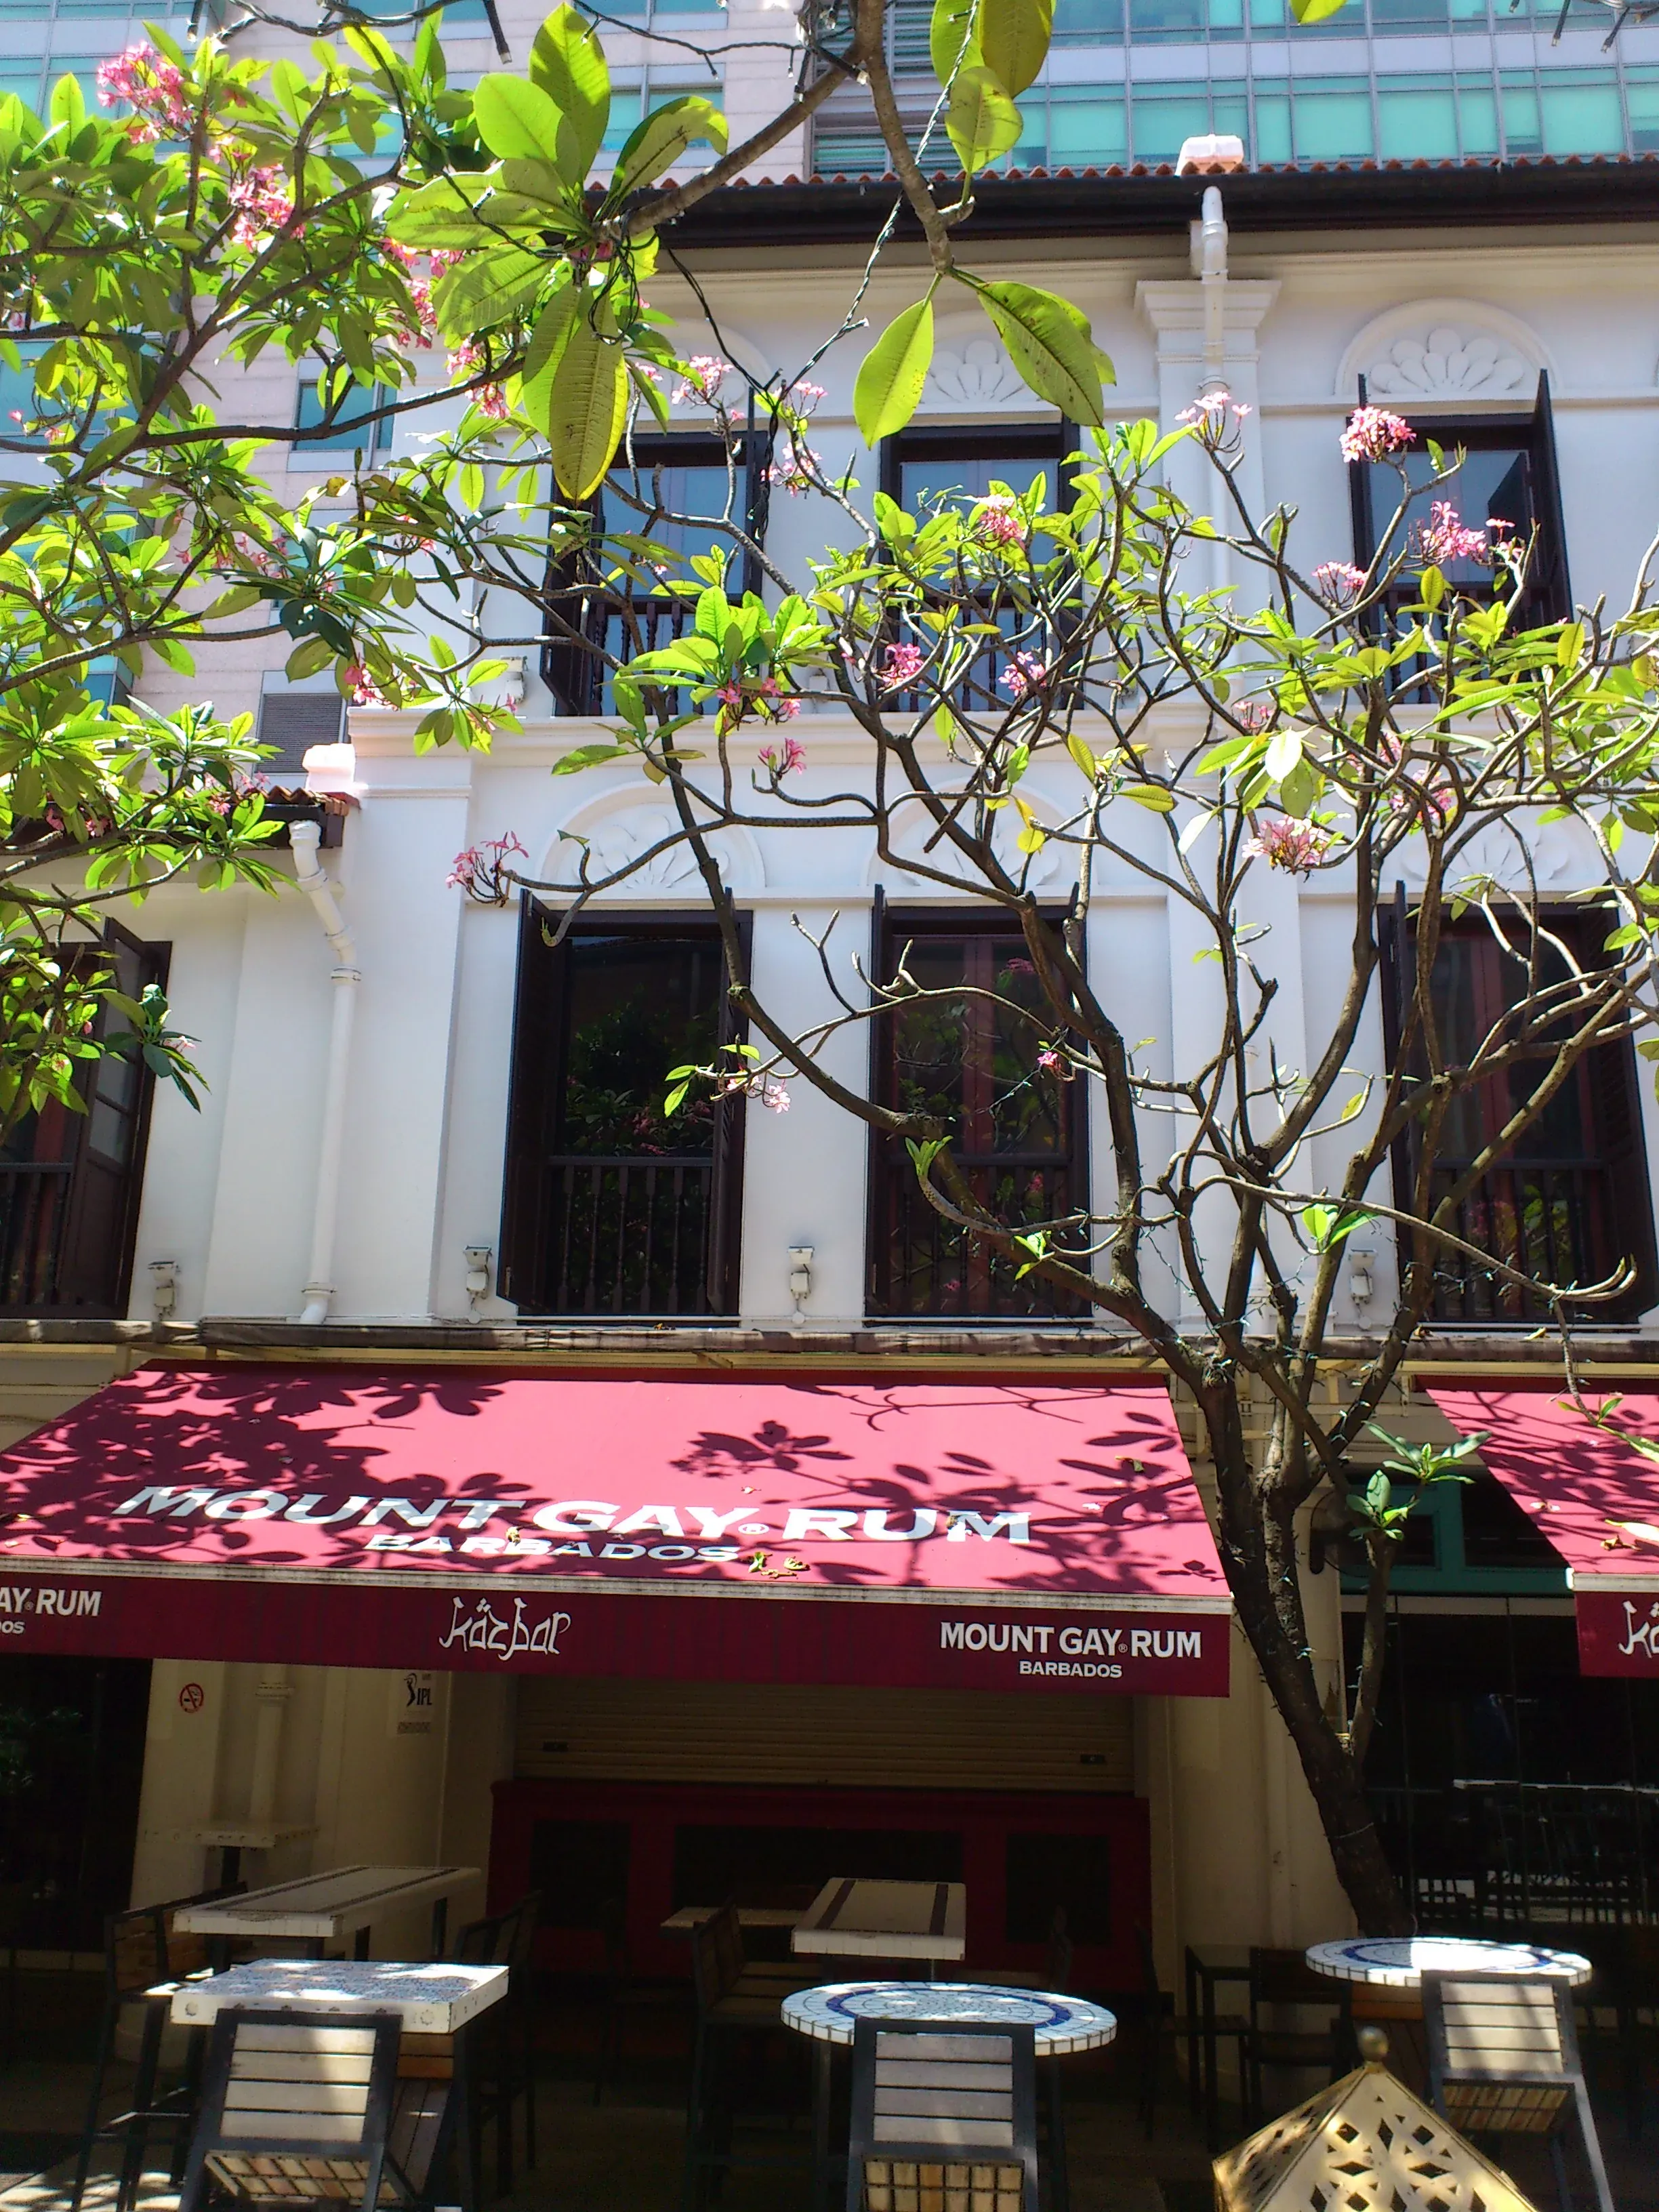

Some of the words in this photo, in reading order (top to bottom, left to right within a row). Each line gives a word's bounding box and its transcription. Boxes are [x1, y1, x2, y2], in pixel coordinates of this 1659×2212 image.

[112, 1486, 526, 1529] MOUNT
[782, 1508, 1032, 1544] RUM
[364, 1533, 741, 1562] BARBADOS
[35, 1589, 102, 1617] RUM
[0, 1620, 26, 1635] OS
[940, 1622, 1054, 1654] MOUNT
[1130, 1629, 1202, 1658] RUM
[1019, 1661, 1122, 1679] BARBADOS
[417, 1687, 432, 1705] IPL
